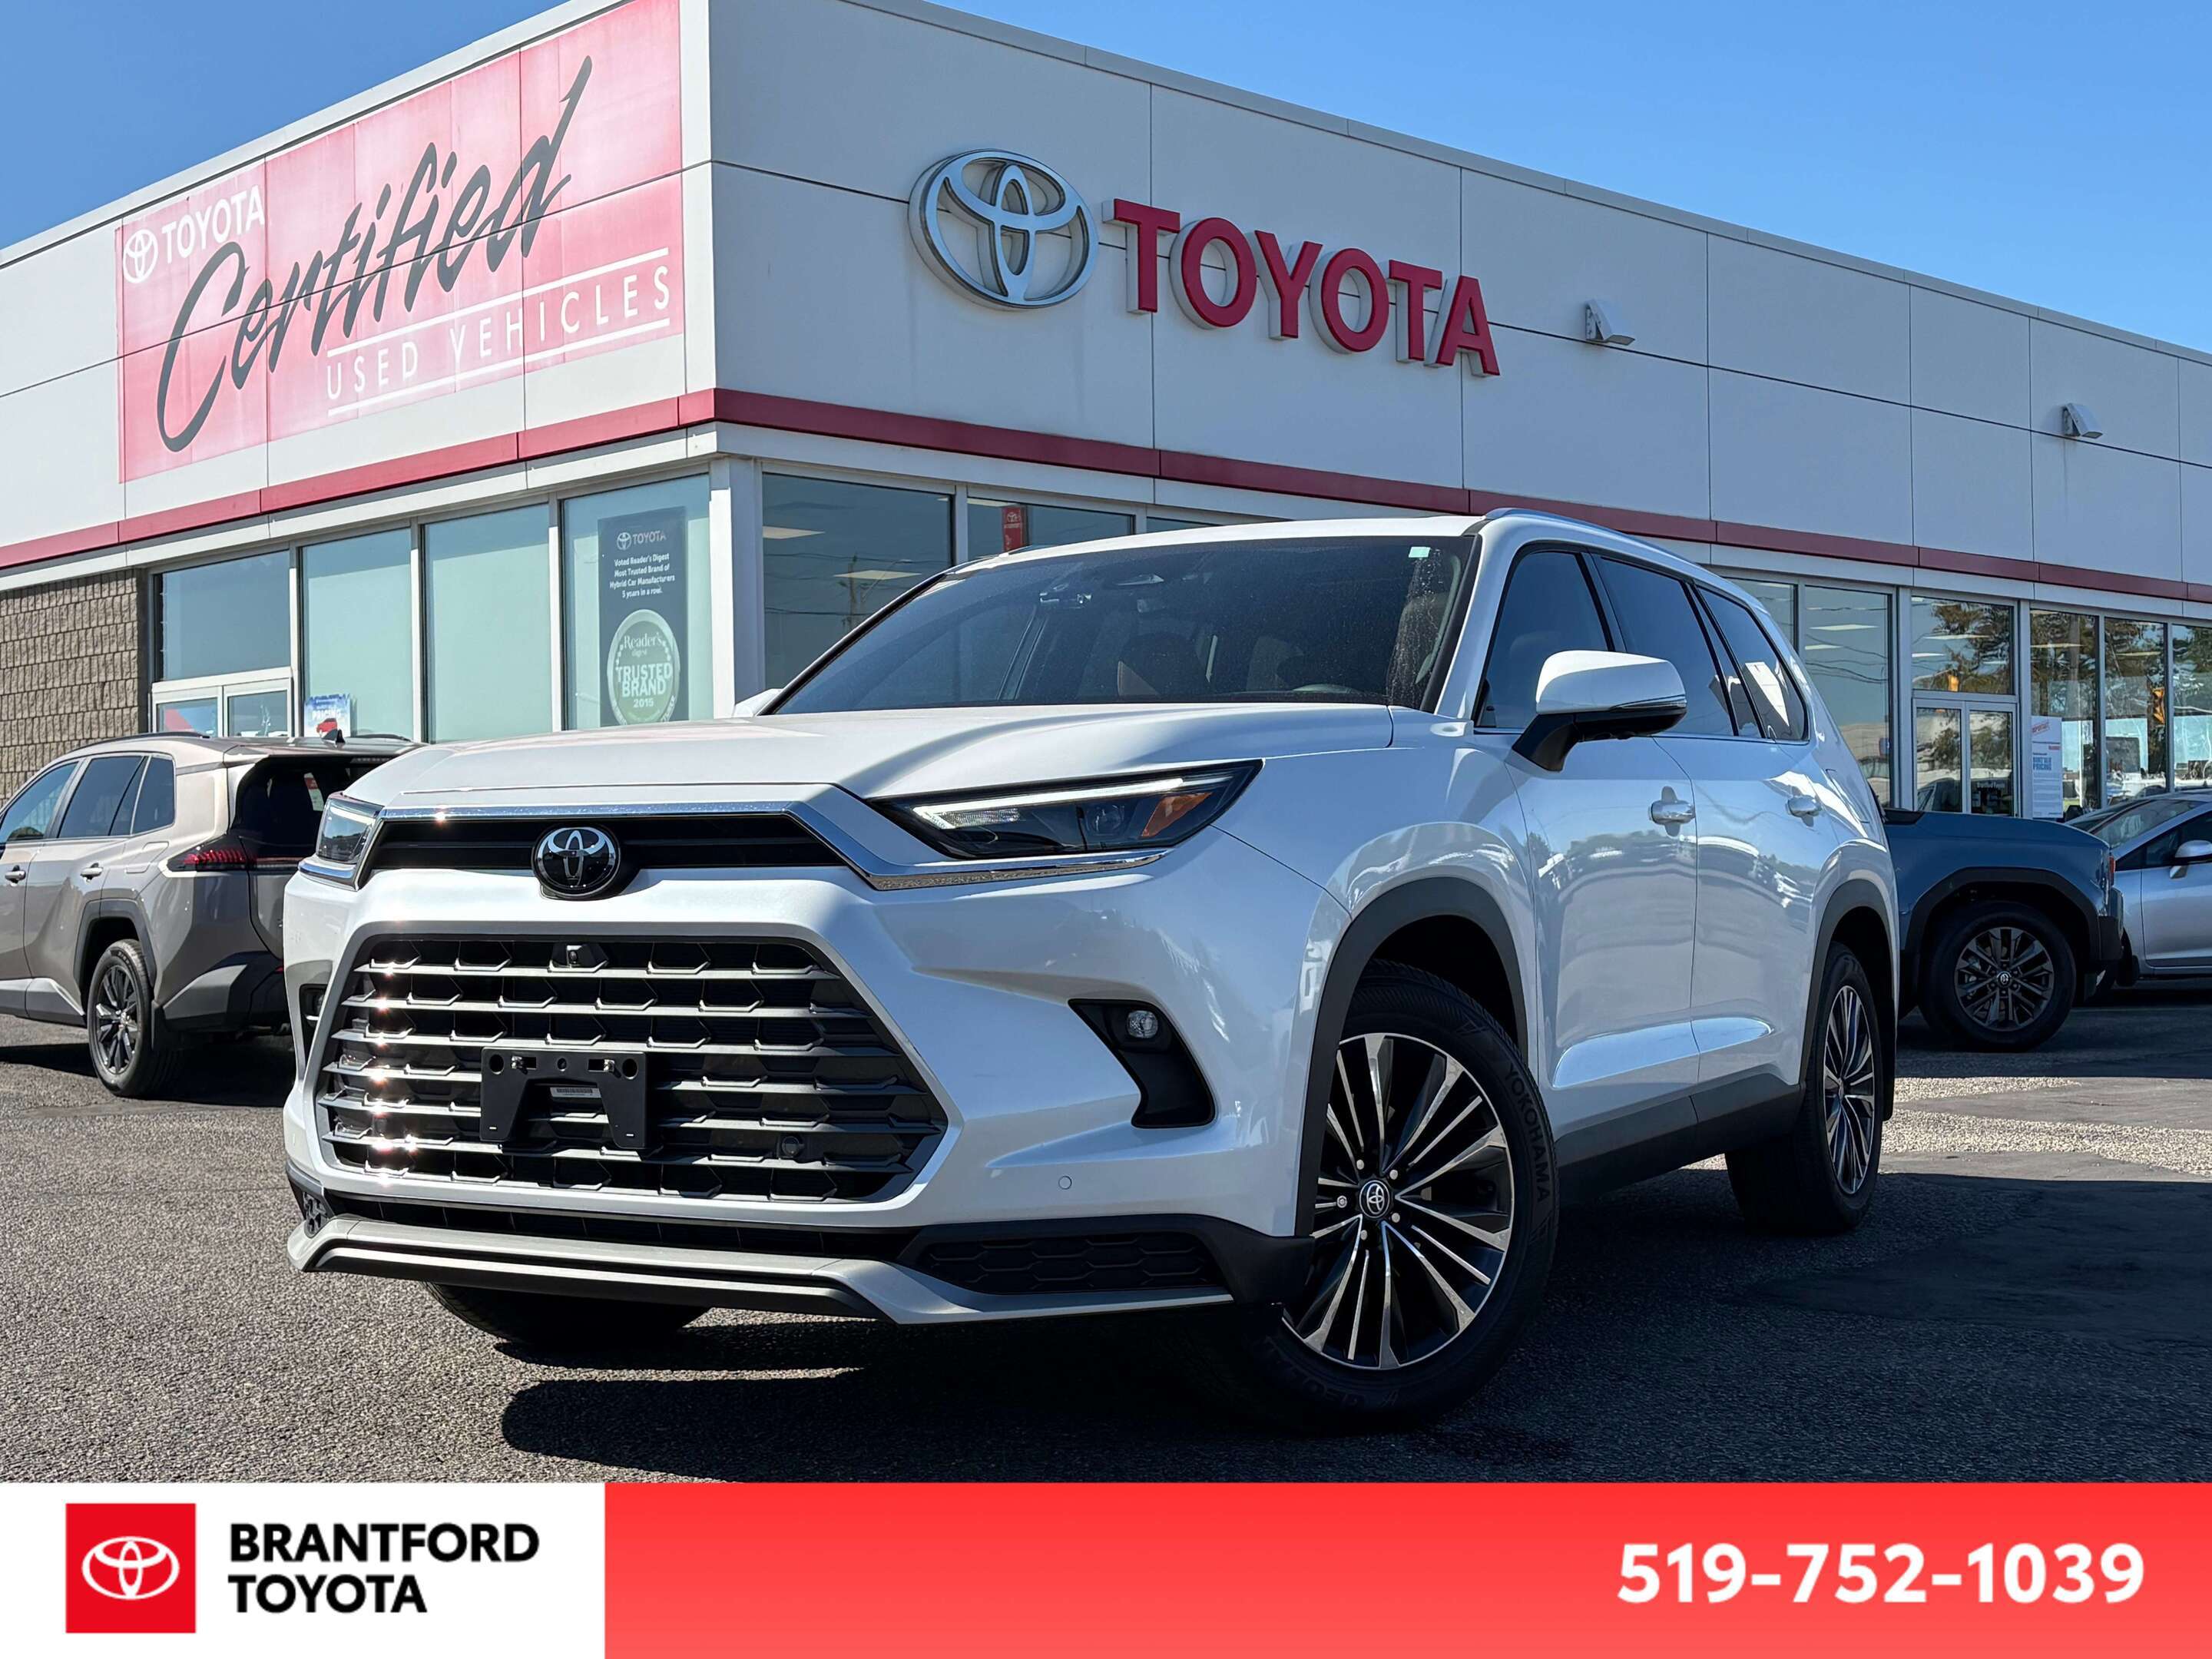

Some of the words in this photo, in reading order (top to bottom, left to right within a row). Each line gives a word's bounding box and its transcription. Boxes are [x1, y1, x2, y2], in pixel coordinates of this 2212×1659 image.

[162, 184, 266, 264] TOYOTA
[157, 55, 592, 452] Certified
[1104, 198, 1500, 377] TOYOTA
[326, 341, 419, 401] USED
[450, 265, 671, 364] VEHICLES
[632, 530, 667, 545] TOYOTA
[614, 558, 630, 567] Voted
[630, 555, 652, 565] Reader's
[652, 552, 670, 563] Digest
[614, 569, 628, 578] Most
[628, 565, 647, 576] Trusted
[647, 563, 664, 574] Brand
[664, 563, 671, 571] of
[609, 579, 628, 591] Hybrid
[627, 578, 637, 587] Car
[637, 575, 675, 586] Manufacturers
[621, 589, 626, 598] 5
[626, 589, 640, 599] years
[640, 588, 646, 596] in
[624, 632, 664, 650] Reader's
[615, 662, 674, 684] TRUSTED
[621, 678, 667, 698] BRAND
[633, 697, 654, 708] 2015
[1504, 1062, 1551, 1203] YOKOHAMA
